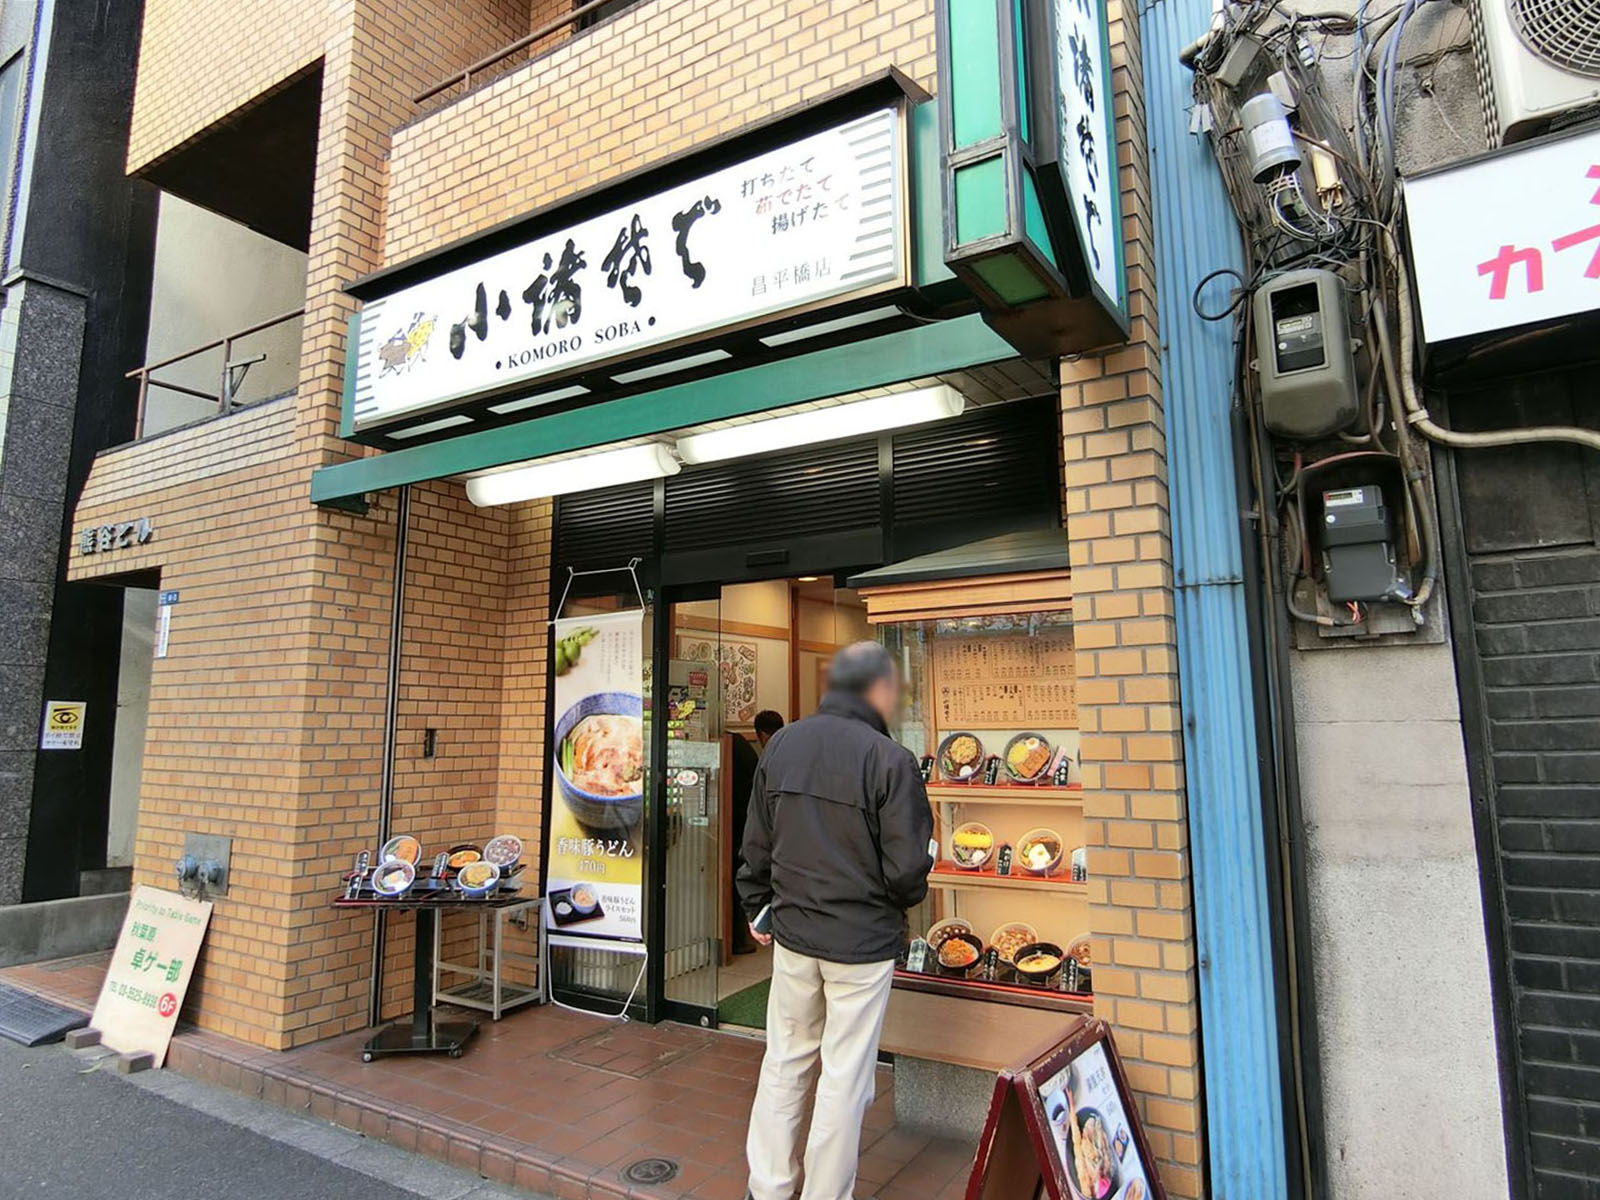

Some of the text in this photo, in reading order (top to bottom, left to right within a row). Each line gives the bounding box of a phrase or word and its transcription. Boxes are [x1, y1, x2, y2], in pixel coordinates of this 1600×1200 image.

[741, 156, 815, 197] 打ちたて
[771, 193, 851, 234] 揚げたて
[751, 257, 832, 296] 昌平橋店
[507, 319, 642, 369] KOMORO SOBA
[557, 837, 634, 858] 香味豚うどん
[131, 948, 183, 983] 卓ゲー部
[160, 994, 175, 1014] 6F
